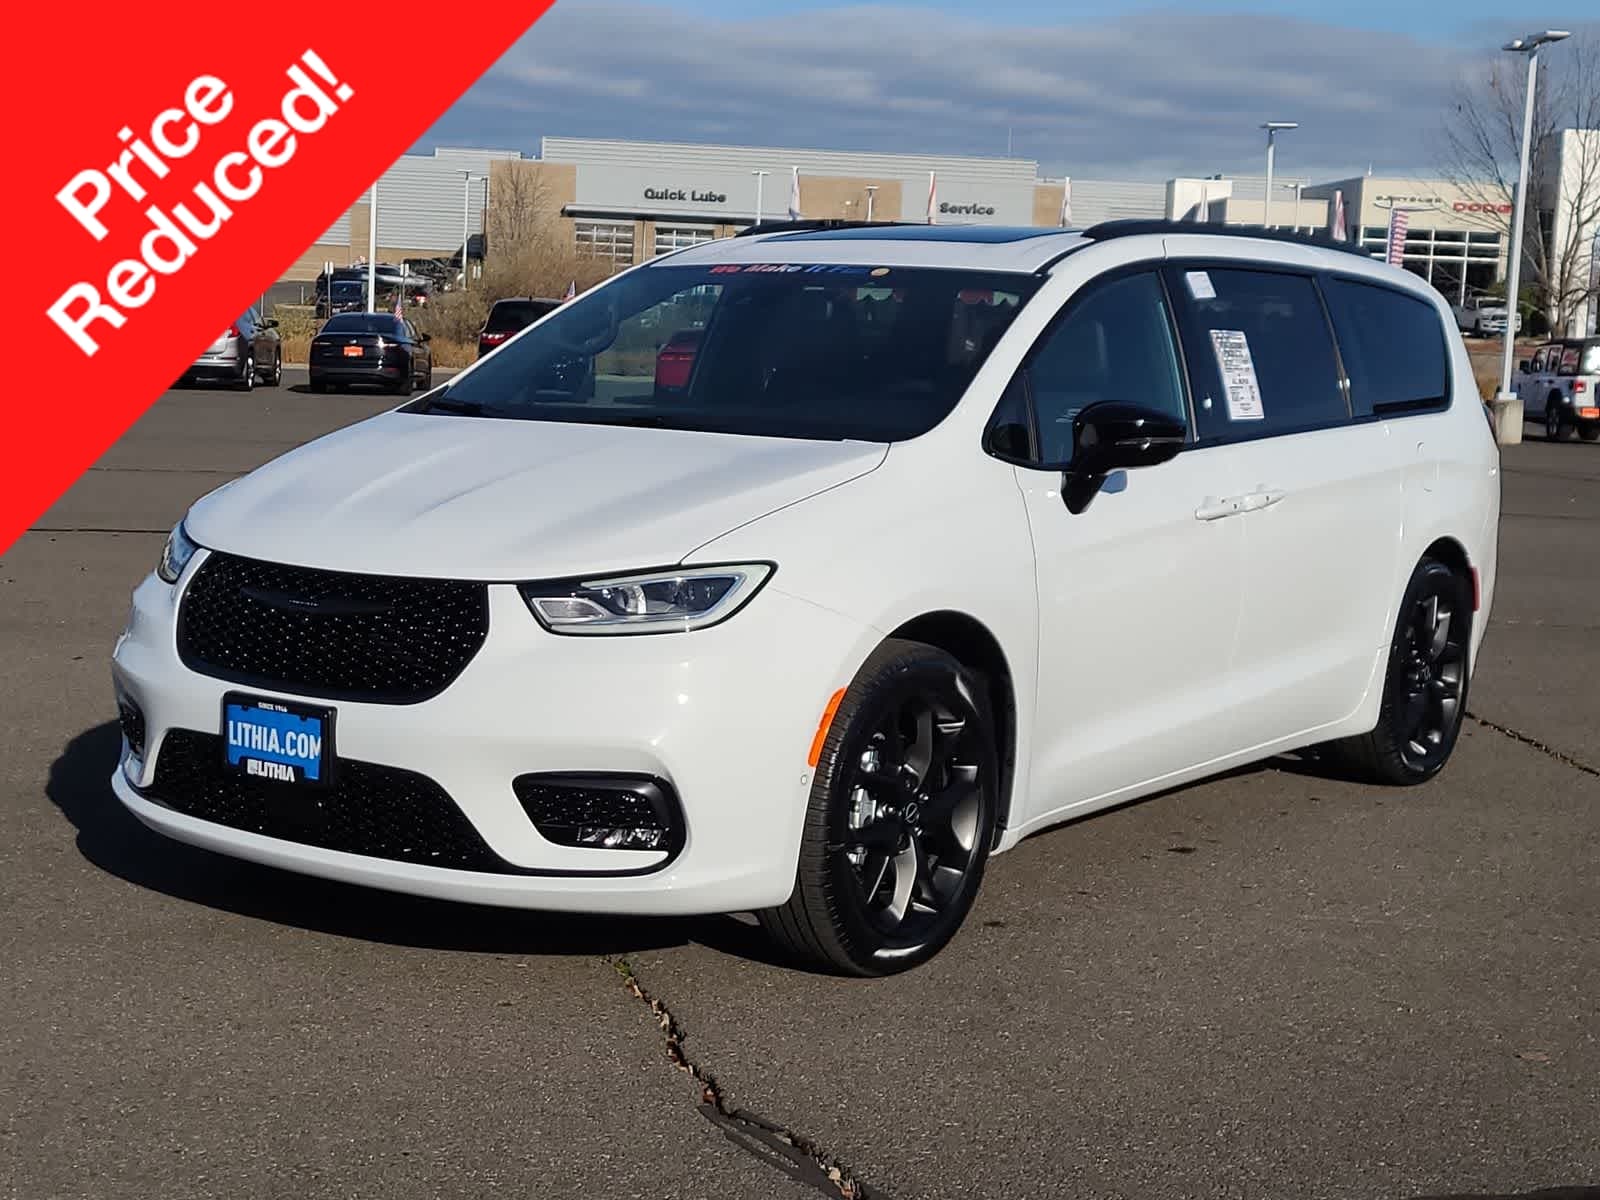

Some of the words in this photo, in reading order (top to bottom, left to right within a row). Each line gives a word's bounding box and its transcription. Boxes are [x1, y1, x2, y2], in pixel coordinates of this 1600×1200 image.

[643, 187, 687, 201] Quick
[691, 189, 727, 203] Lube
[940, 202, 995, 216] Service
[1453, 202, 1512, 214] DODG
[228, 720, 322, 760] LITHIA.COM
[258, 760, 296, 783] LITHIA
